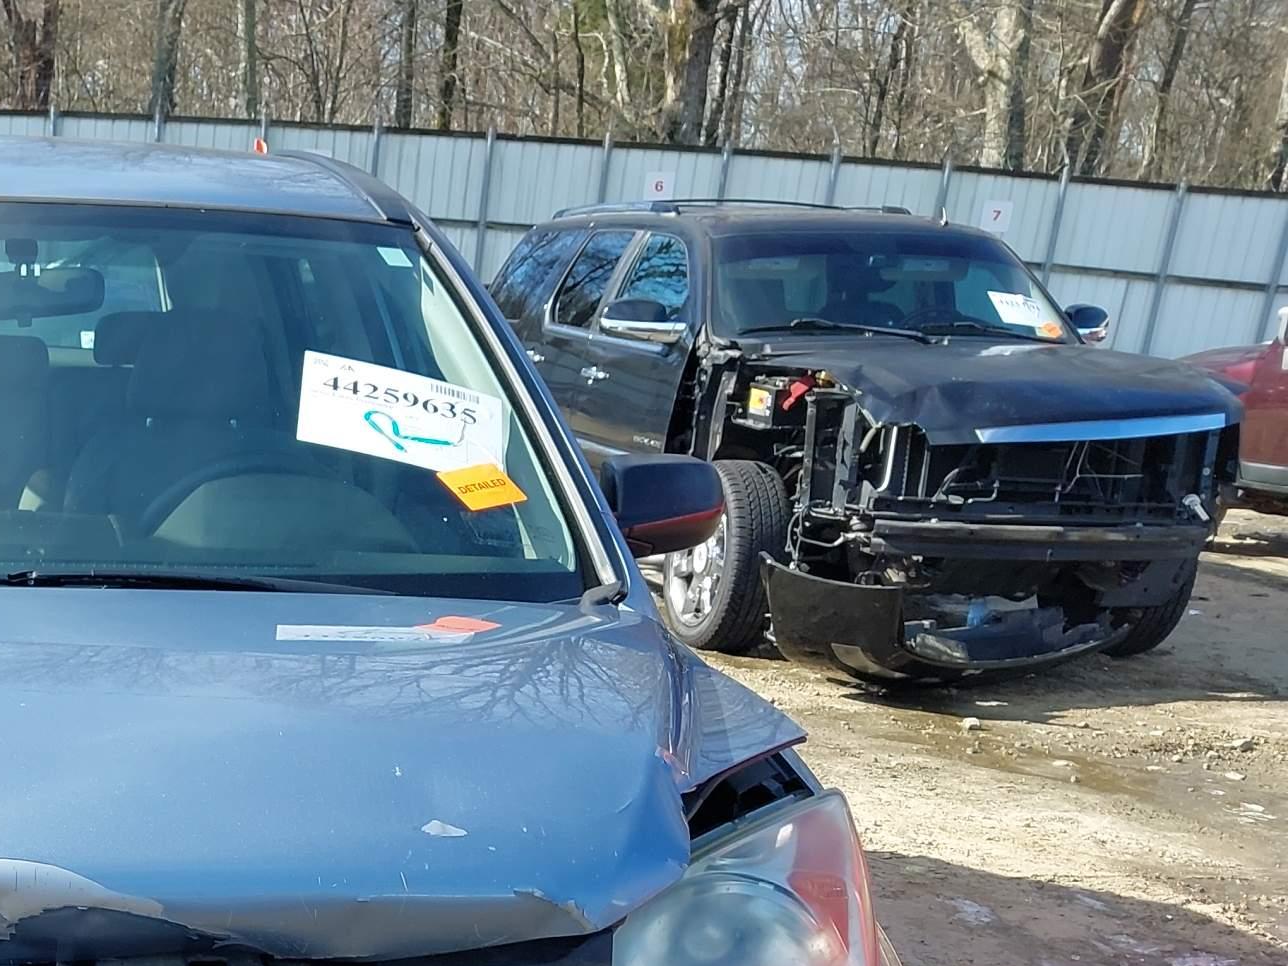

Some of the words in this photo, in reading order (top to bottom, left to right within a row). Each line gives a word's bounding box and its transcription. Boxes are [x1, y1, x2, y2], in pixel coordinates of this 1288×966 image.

[655, 180, 664, 192] 6
[992, 209, 1001, 221] 7
[322, 375, 477, 425] 44259635
[457, 478, 507, 495] DETAILED
